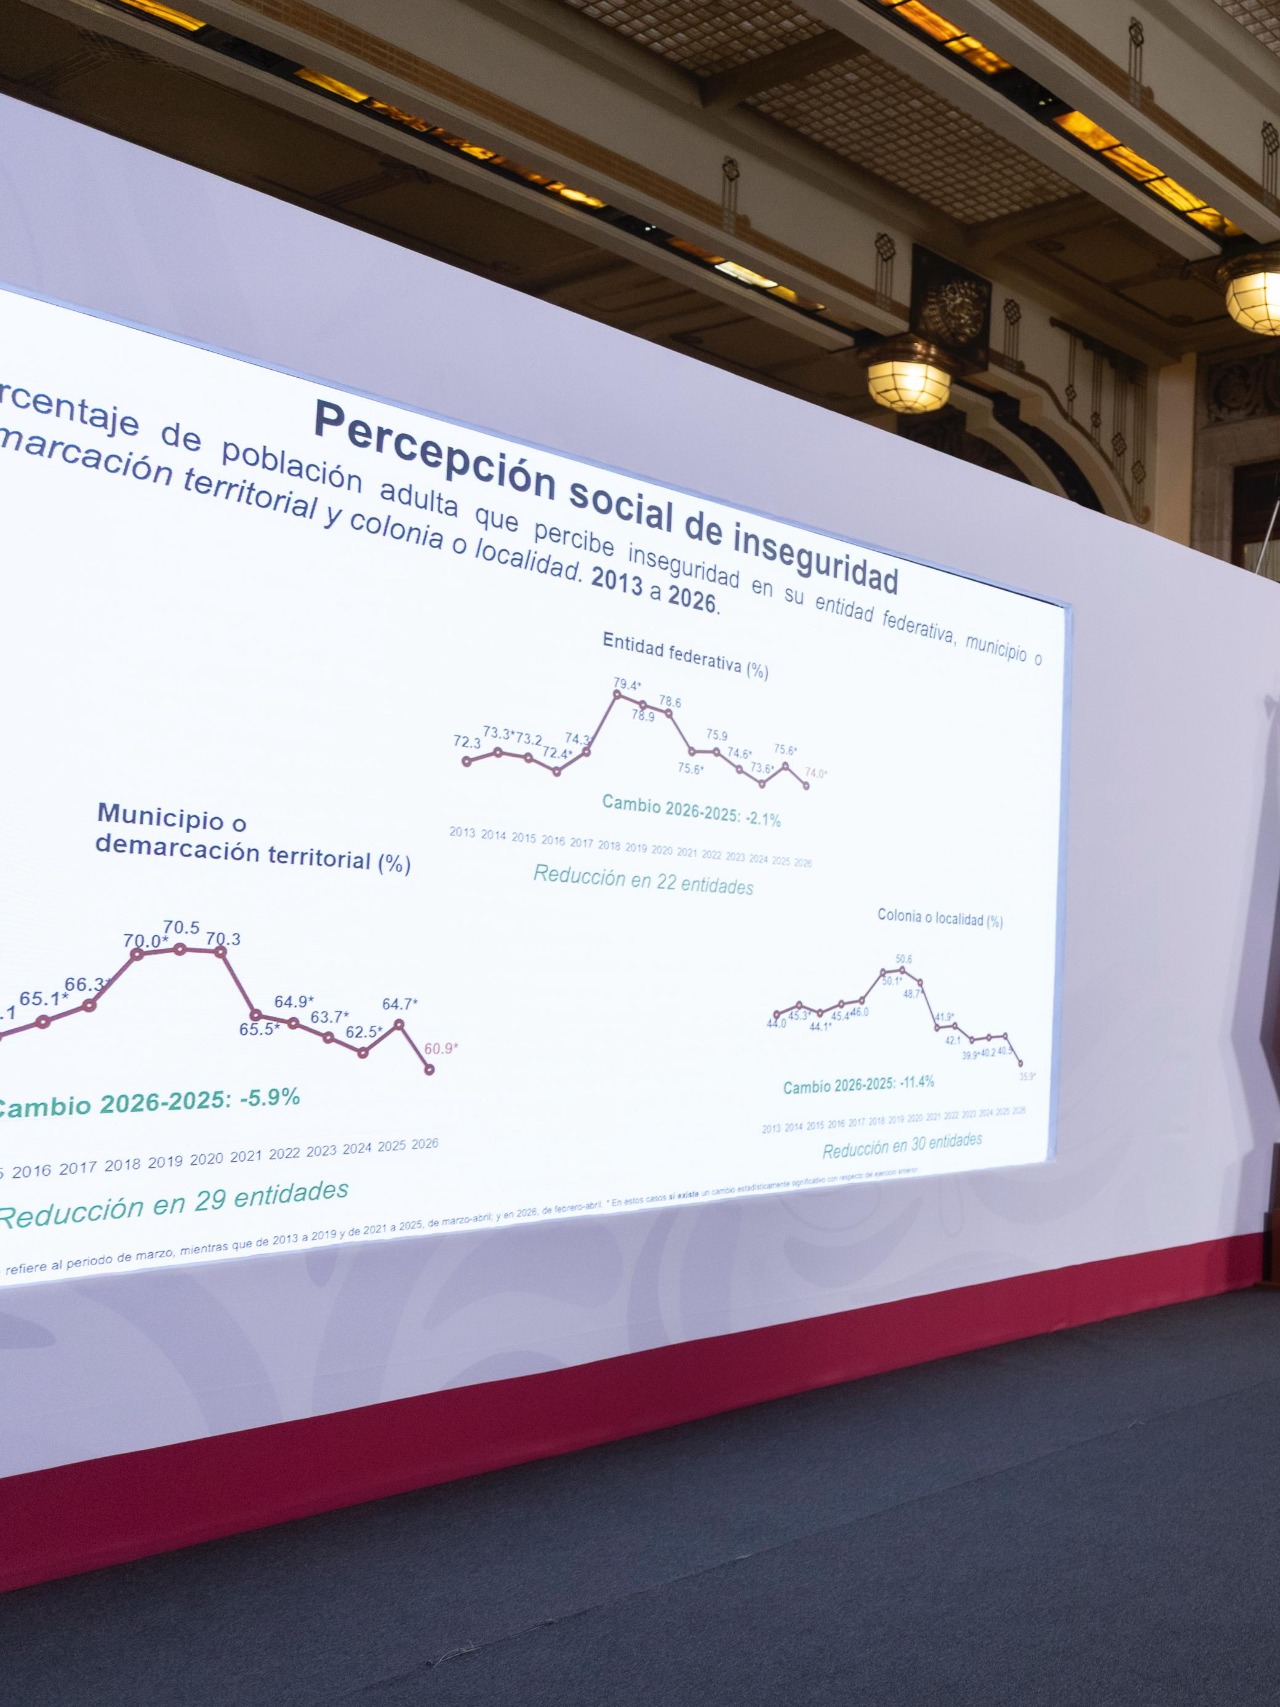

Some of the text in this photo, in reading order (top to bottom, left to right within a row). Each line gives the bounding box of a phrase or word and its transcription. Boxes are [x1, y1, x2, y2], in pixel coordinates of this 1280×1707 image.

[315, 399, 898, 595] Percepción social de inseguridad
[161, 422, 201, 452] de
[223, 441, 362, 493] población
[380, 480, 458, 518] adulta
[475, 508, 518, 532] que
[535, 523, 614, 556] percibe
[629, 542, 739, 589] inseguridad
[752, 580, 772, 597] en
[785, 588, 803, 605] su
[816, 597, 874, 622] entidad
[883, 610, 956, 646] federativa,
[966, 636, 1026, 662] municipio
[1035, 654, 1042, 665] o
[184, 468, 318, 519] territorial
[324, 506, 343, 529] y
[351, 513, 443, 550] colonia
[452, 538, 467, 554] o
[475, 538, 582, 582] localidad.
[591, 566, 642, 596] 2013
[650, 585, 661, 601] a
[668, 584, 720, 615] 2026.
[603, 631, 768, 681] Entidad federativa (%)
[98, 802, 246, 833] Municipio o
[603, 793, 781, 827] Cambio 2026-2025: -2.1%
[96, 833, 410, 876] demarcación territorial (%)
[534, 864, 753, 895] Reducción en 22 entidades
[163, 920, 200, 935] 70.5
[878, 908, 1003, 930] Colonia o localidad (%)
[206, 932, 241, 946] 70.3
[100, 1090, 231, 1114] 2026-2025:
[240, 1087, 300, 1106] -5.9%
[784, 1075, 934, 1094] Cambio 2026-2025: -11.4%
[12, 1164, 51, 1179] 2016
[59, 1161, 97, 1175] 2017
[105, 1158, 140, 1172] 2018
[148, 1155, 183, 1169] 2019
[190, 1153, 223, 1166] 2020
[230, 1150, 261, 1163] 2021
[269, 1147, 300, 1160] 2022
[307, 1145, 337, 1157] 2023
[343, 1143, 371, 1155] 2024
[378, 1140, 406, 1152] 2025
[412, 1138, 438, 1149] 2026
[823, 1132, 982, 1159] Reducción en 30 entidades
[153, 1197, 185, 1215] en
[195, 1189, 226, 1211] 29
[234, 1180, 349, 1207] entidades
